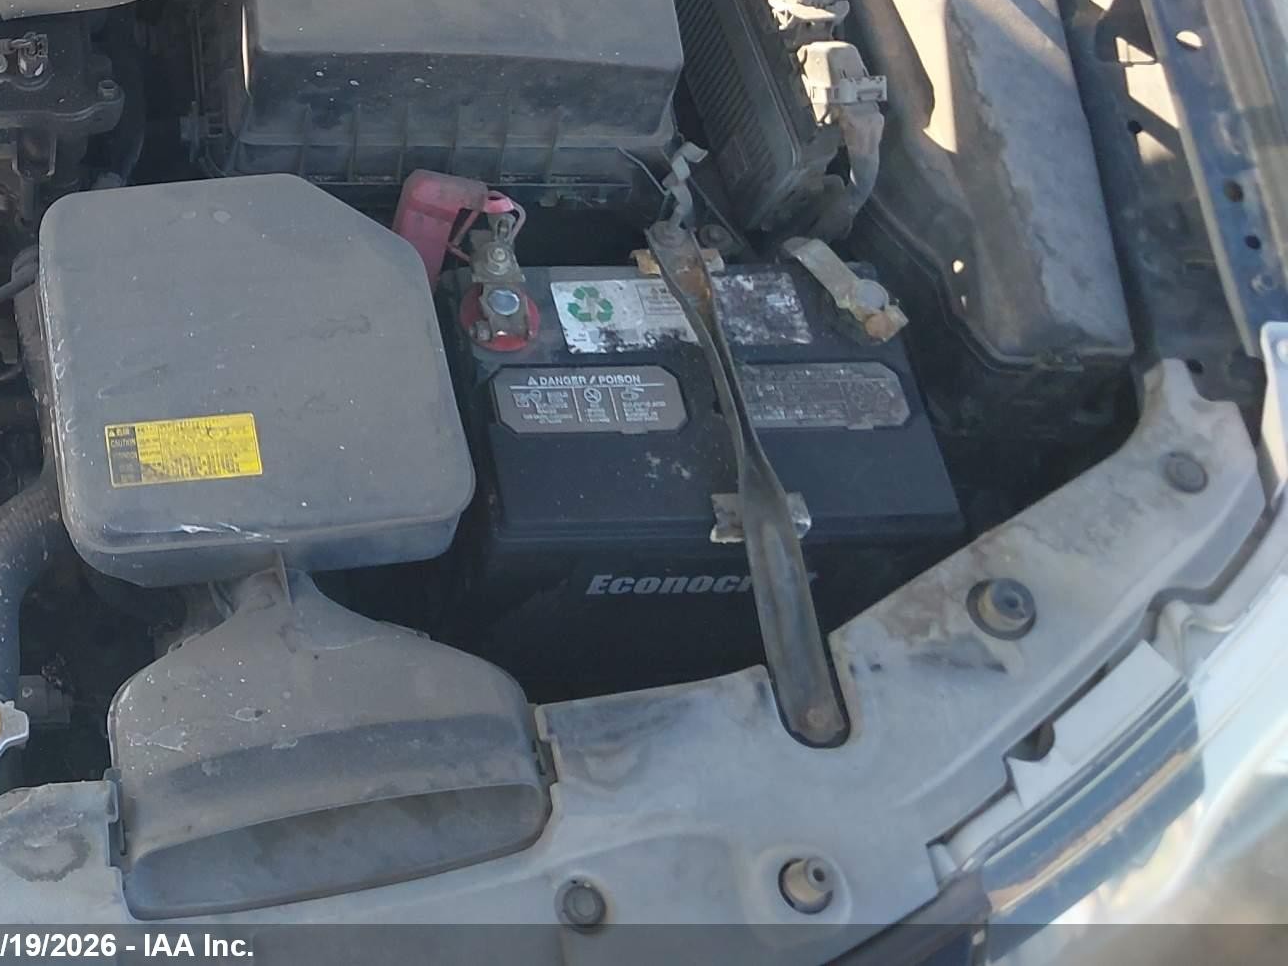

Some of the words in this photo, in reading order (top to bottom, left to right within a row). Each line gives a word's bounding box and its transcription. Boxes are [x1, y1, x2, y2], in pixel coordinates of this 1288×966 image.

[539, 375, 586, 386] DANGER
[598, 374, 641, 385] POISON
[111, 438, 136, 448] CAUTION
